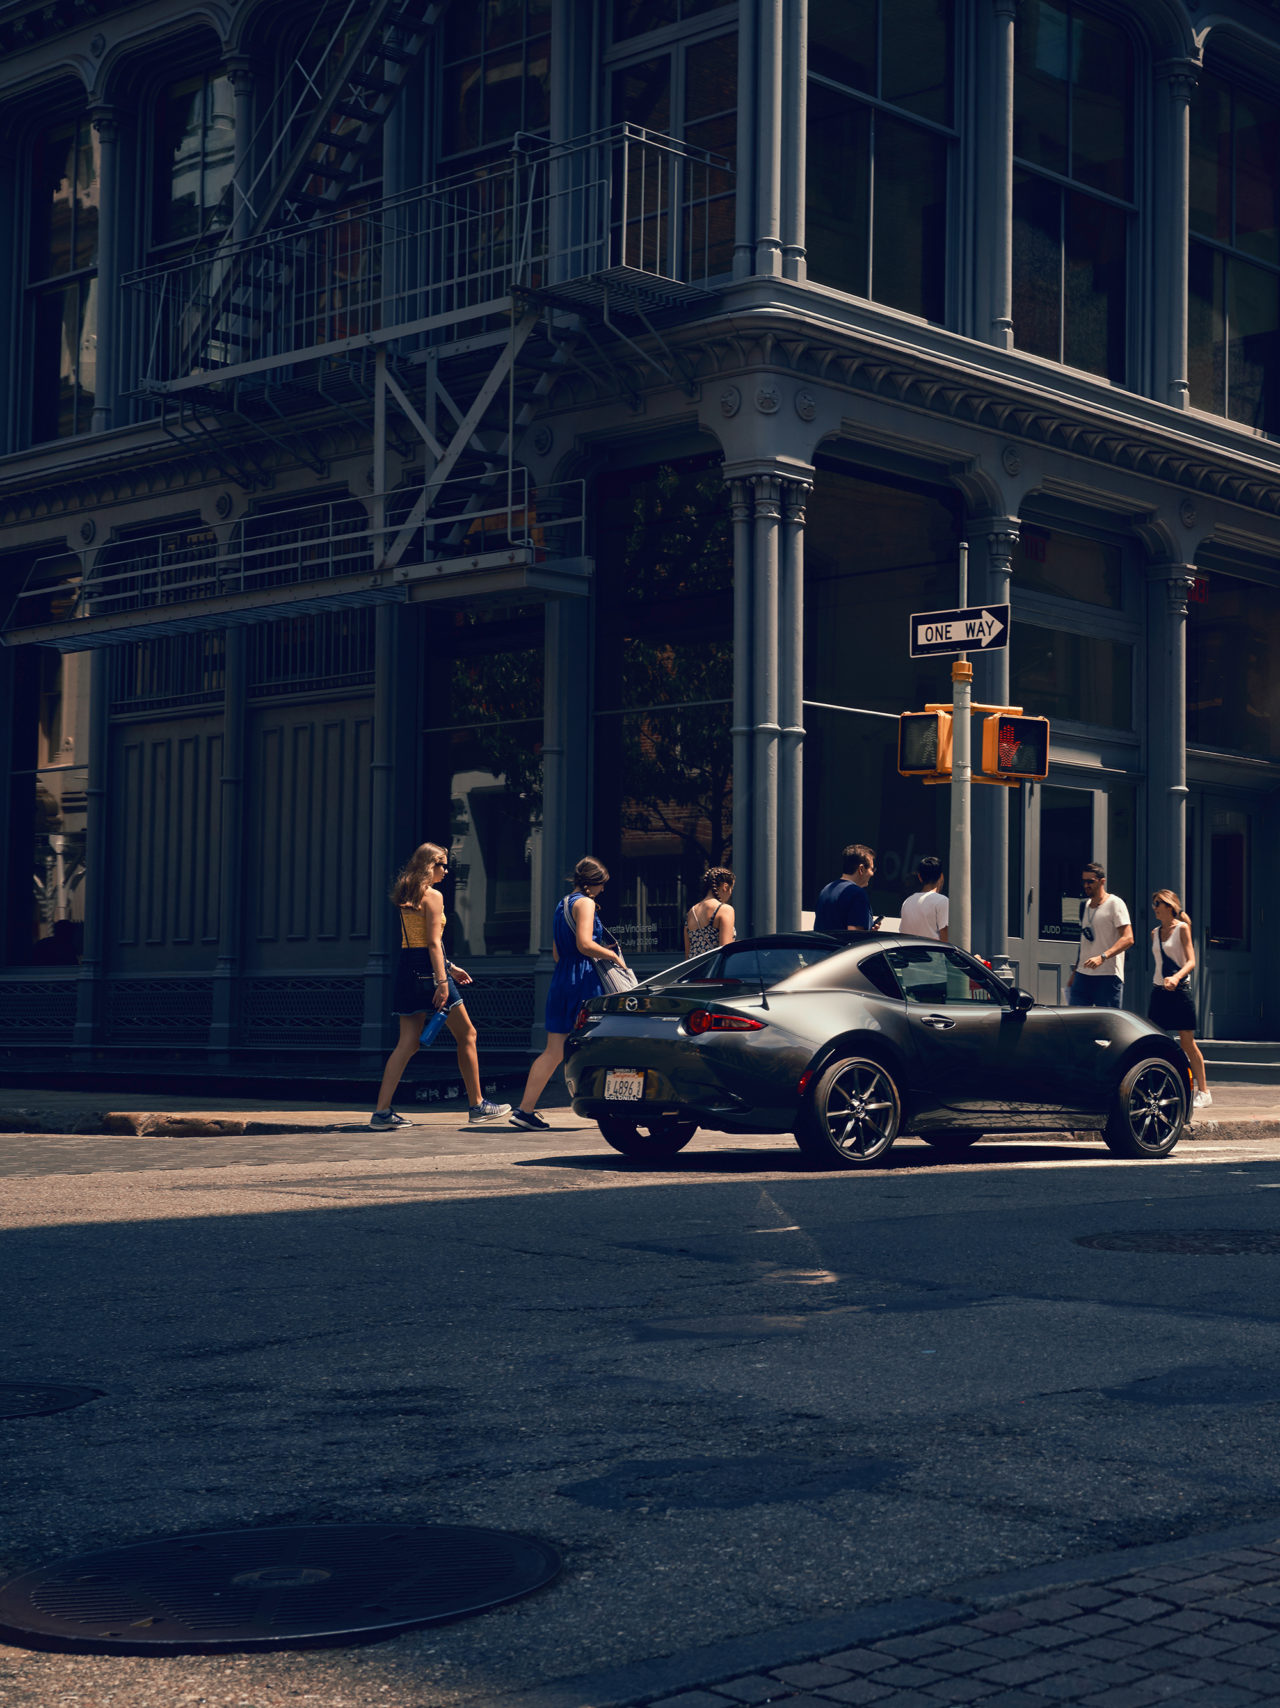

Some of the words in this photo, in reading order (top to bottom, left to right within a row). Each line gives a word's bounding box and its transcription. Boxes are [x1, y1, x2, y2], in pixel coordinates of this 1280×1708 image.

[925, 624, 953, 642] ONE
[965, 620, 995, 638] WAY
[1041, 924, 1061, 935] JUDD
[613, 1081, 635, 1096] 4896
